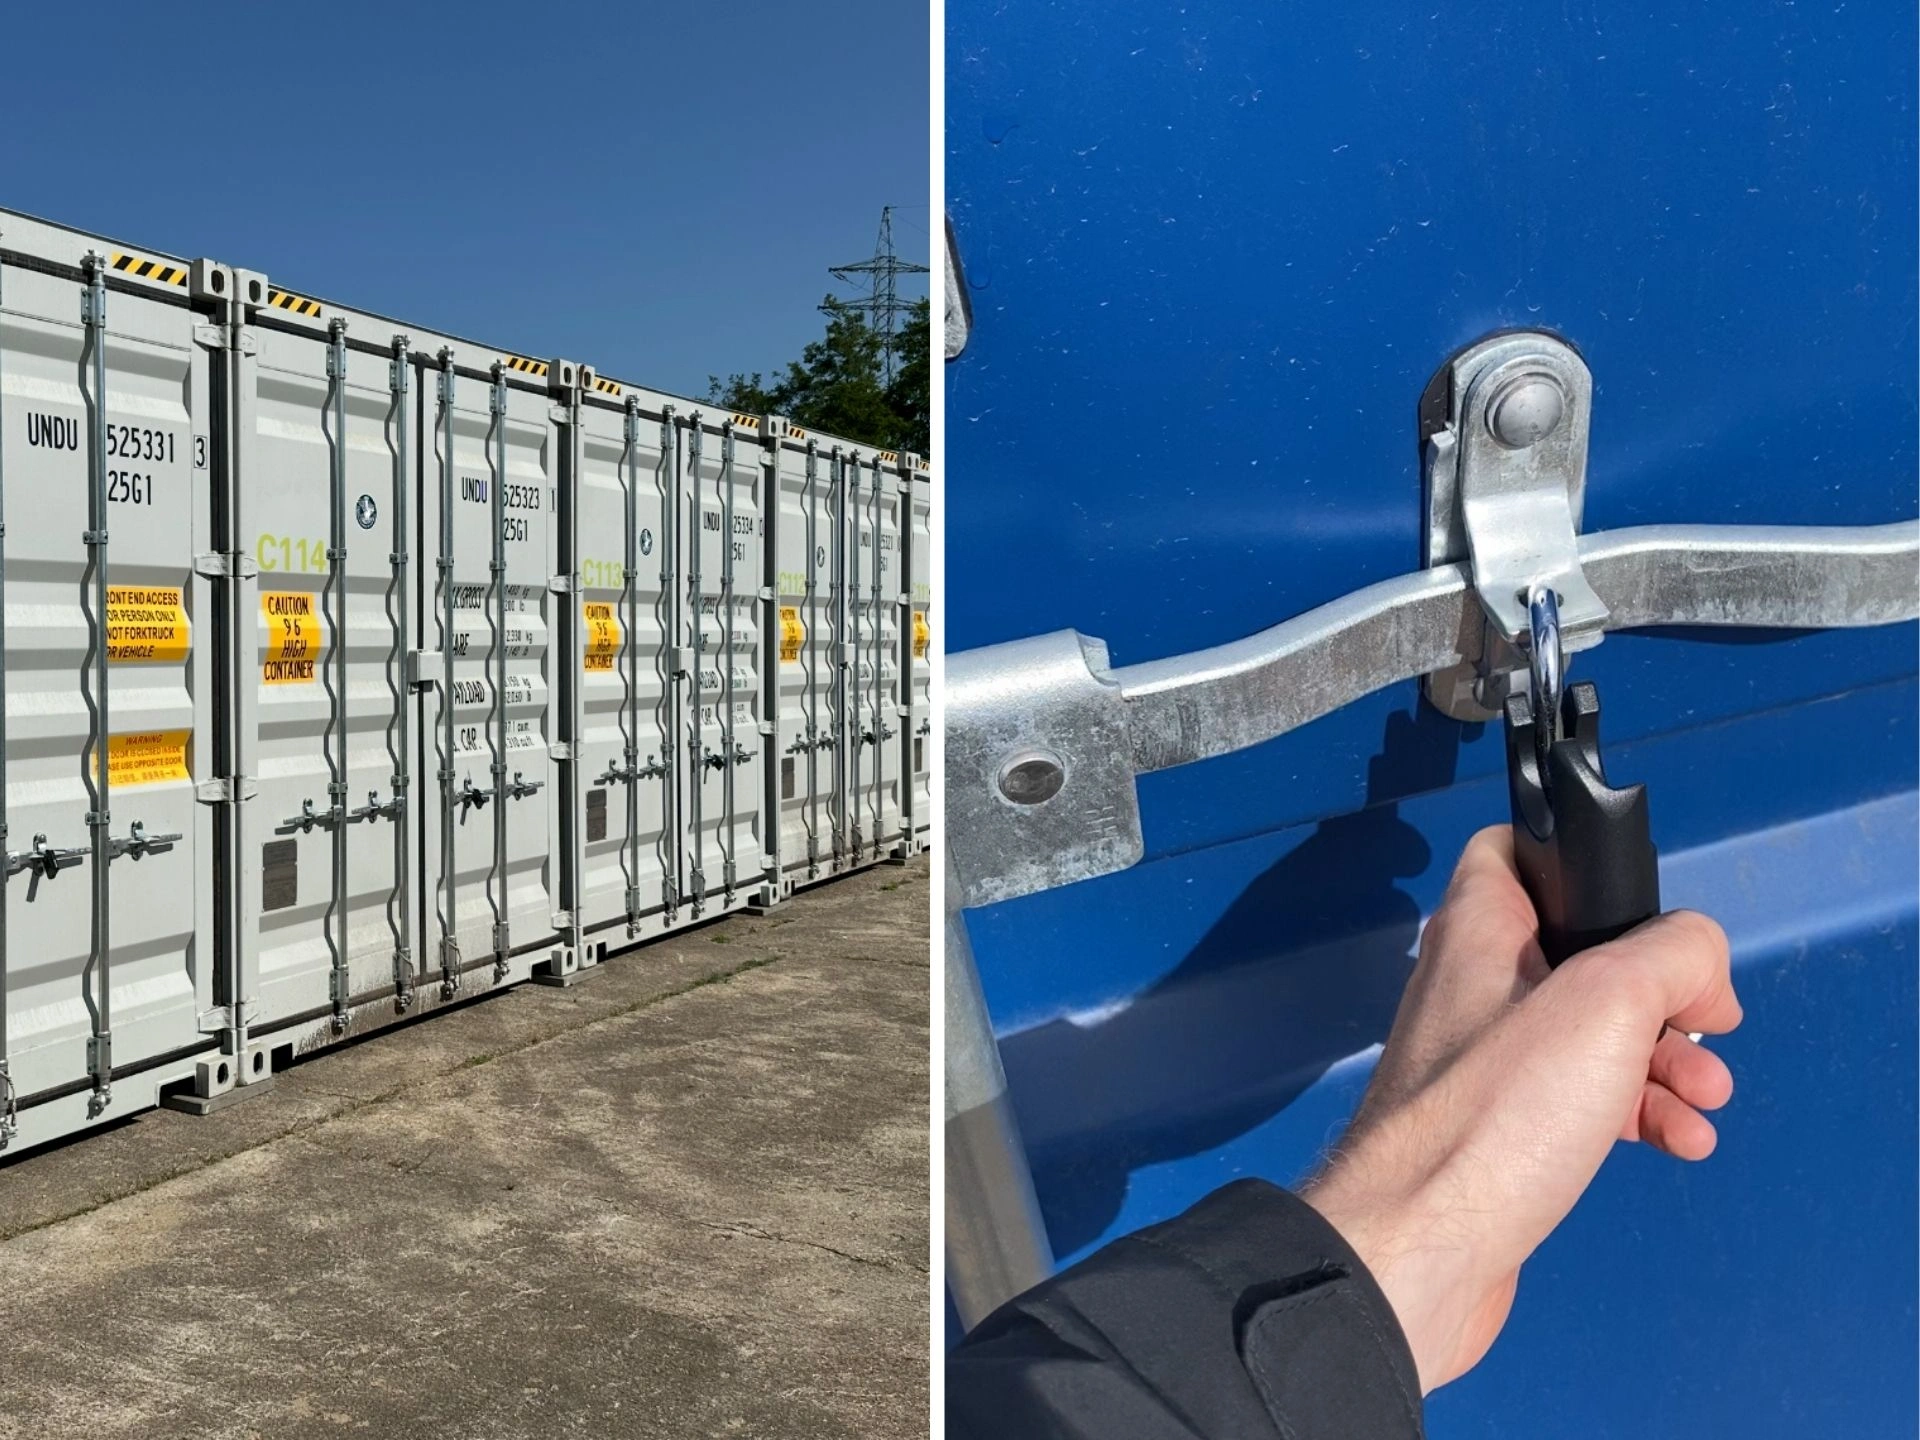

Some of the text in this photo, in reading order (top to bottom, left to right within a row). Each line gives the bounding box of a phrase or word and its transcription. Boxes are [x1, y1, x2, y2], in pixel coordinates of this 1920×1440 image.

[28, 412, 206, 468] UNDU 525331 3
[108, 470, 152, 505] 25G1
[461, 476, 488, 504] UNDU
[504, 484, 540, 510] 525323
[504, 517, 528, 542] 25G1
[257, 533, 327, 573] C114
[583, 557, 622, 588] C113
[128, 591, 145, 605] END
[146, 591, 178, 606] ACCESS
[268, 596, 310, 616] CAUTION
[121, 609, 156, 622] PERSON
[156, 610, 176, 622] ONLY
[125, 626, 175, 640] FORKTRUCK
[118, 645, 155, 658] VEHICLE
[281, 639, 307, 658] HIGH
[264, 659, 314, 681] CONTAINER
[126, 734, 163, 746] WARNING
[134, 758, 163, 768] OPPOSITE
